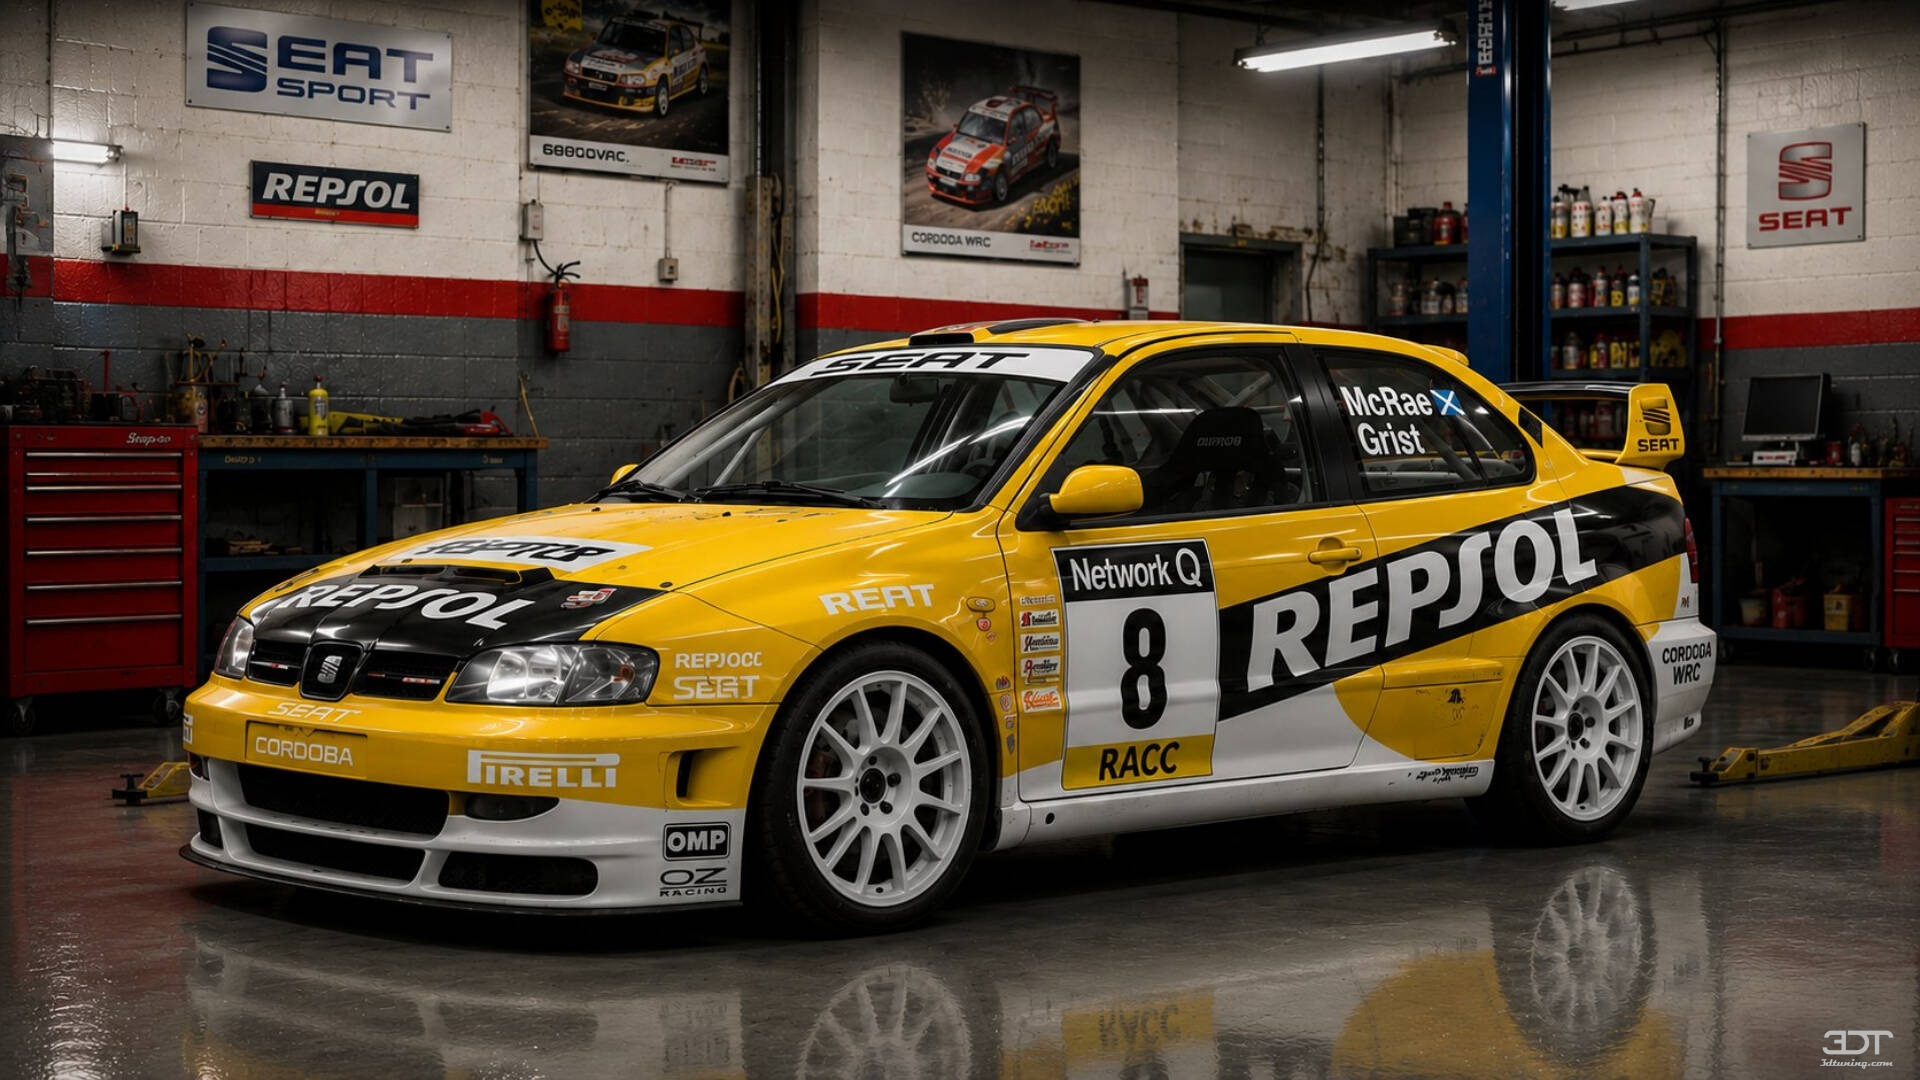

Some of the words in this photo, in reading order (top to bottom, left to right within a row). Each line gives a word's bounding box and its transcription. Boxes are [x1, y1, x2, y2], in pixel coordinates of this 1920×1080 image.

[207, 26, 433, 92] SEAT
[277, 78, 430, 110] SPORT
[262, 172, 409, 210] REPSOL
[1758, 206, 1852, 231] SEAT
[965, 235, 991, 248] WRC
[811, 352, 1030, 376] SEAT
[1340, 386, 1432, 416] McRae
[1357, 422, 1425, 456] Grist
[1637, 438, 1679, 452] SEAT
[1069, 554, 1173, 591] Network
[1175, 548, 1202, 587] Q
[274, 584, 536, 631] REPSOL
[818, 583, 934, 616] REAT
[1247, 508, 1598, 692] REPSOL
[1121, 607, 1168, 730] 8
[1673, 662, 1701, 685] WRC
[267, 702, 362, 722] SEAT
[255, 736, 353, 767] CORDOBA
[1099, 742, 1180, 781] RACC
[467, 750, 620, 787] PIRELLI
[666, 829, 726, 853] OMP
[659, 867, 728, 886] OZ
[659, 886, 727, 897] RACING
